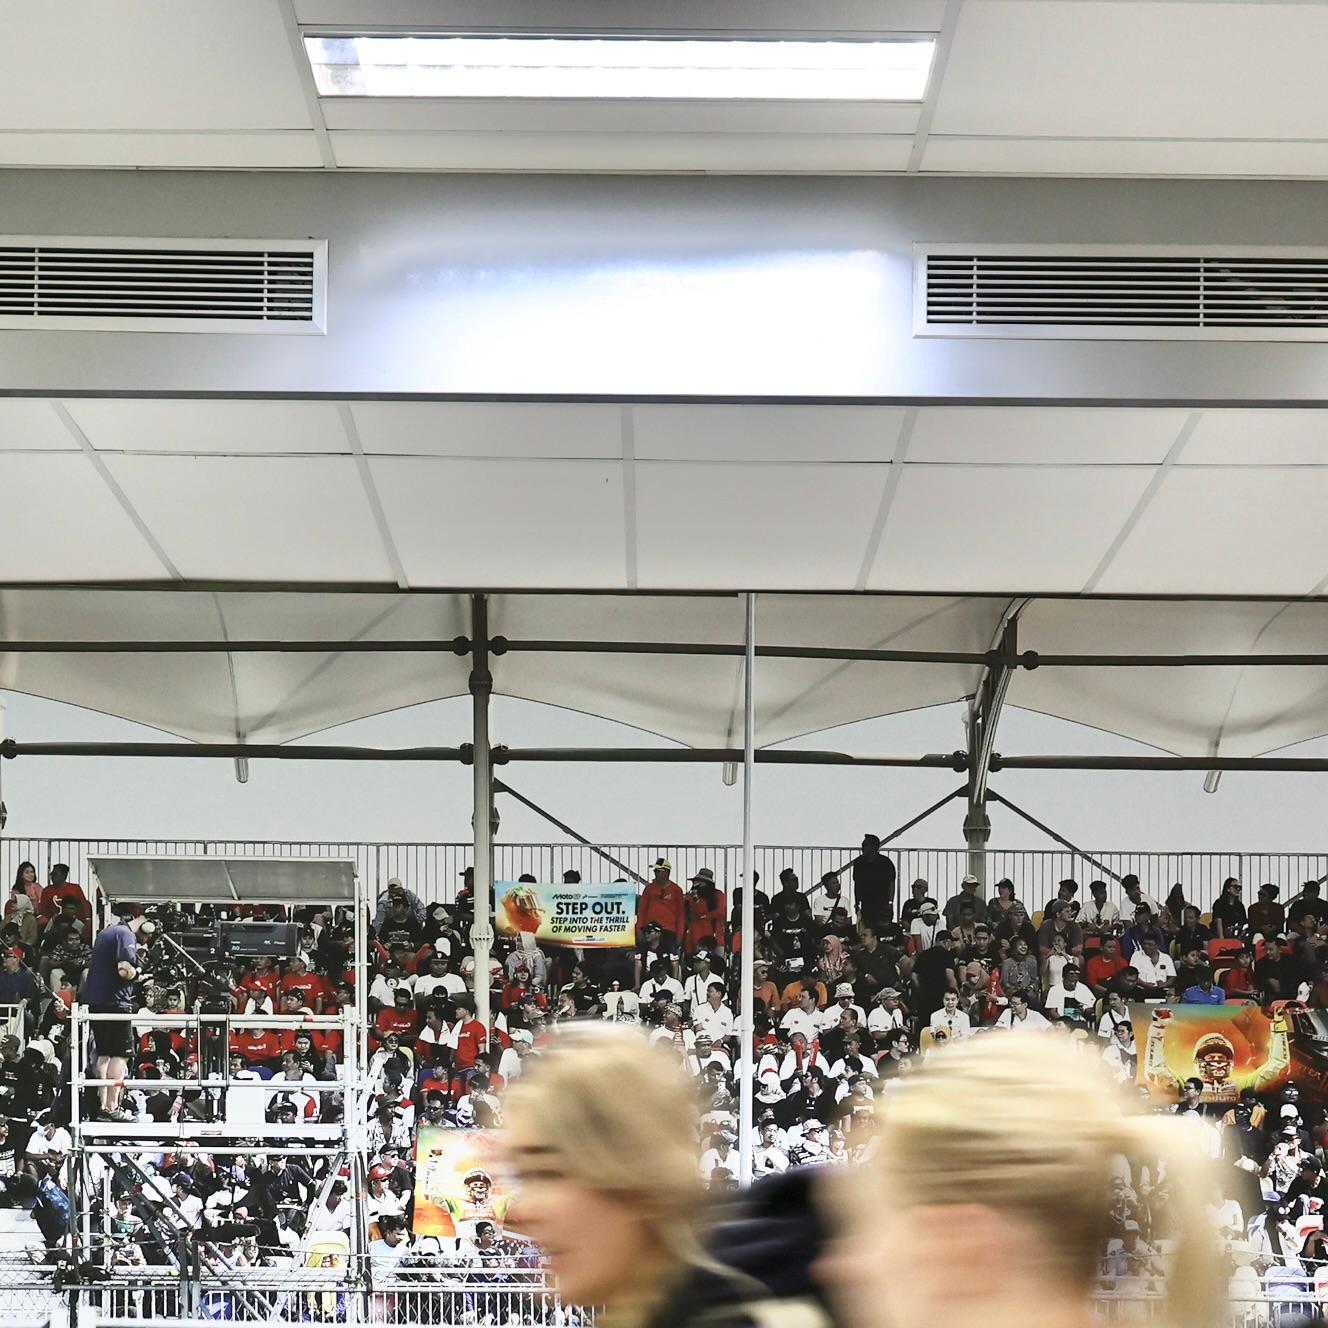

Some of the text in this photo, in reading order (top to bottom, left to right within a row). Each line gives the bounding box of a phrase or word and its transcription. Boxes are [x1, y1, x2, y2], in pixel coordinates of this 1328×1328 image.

[556, 902, 626, 915] STEP OUT.
[550, 916, 630, 925] STEP INTO THE THRILL
[551, 924, 626, 934] OF MOVING FASTER
